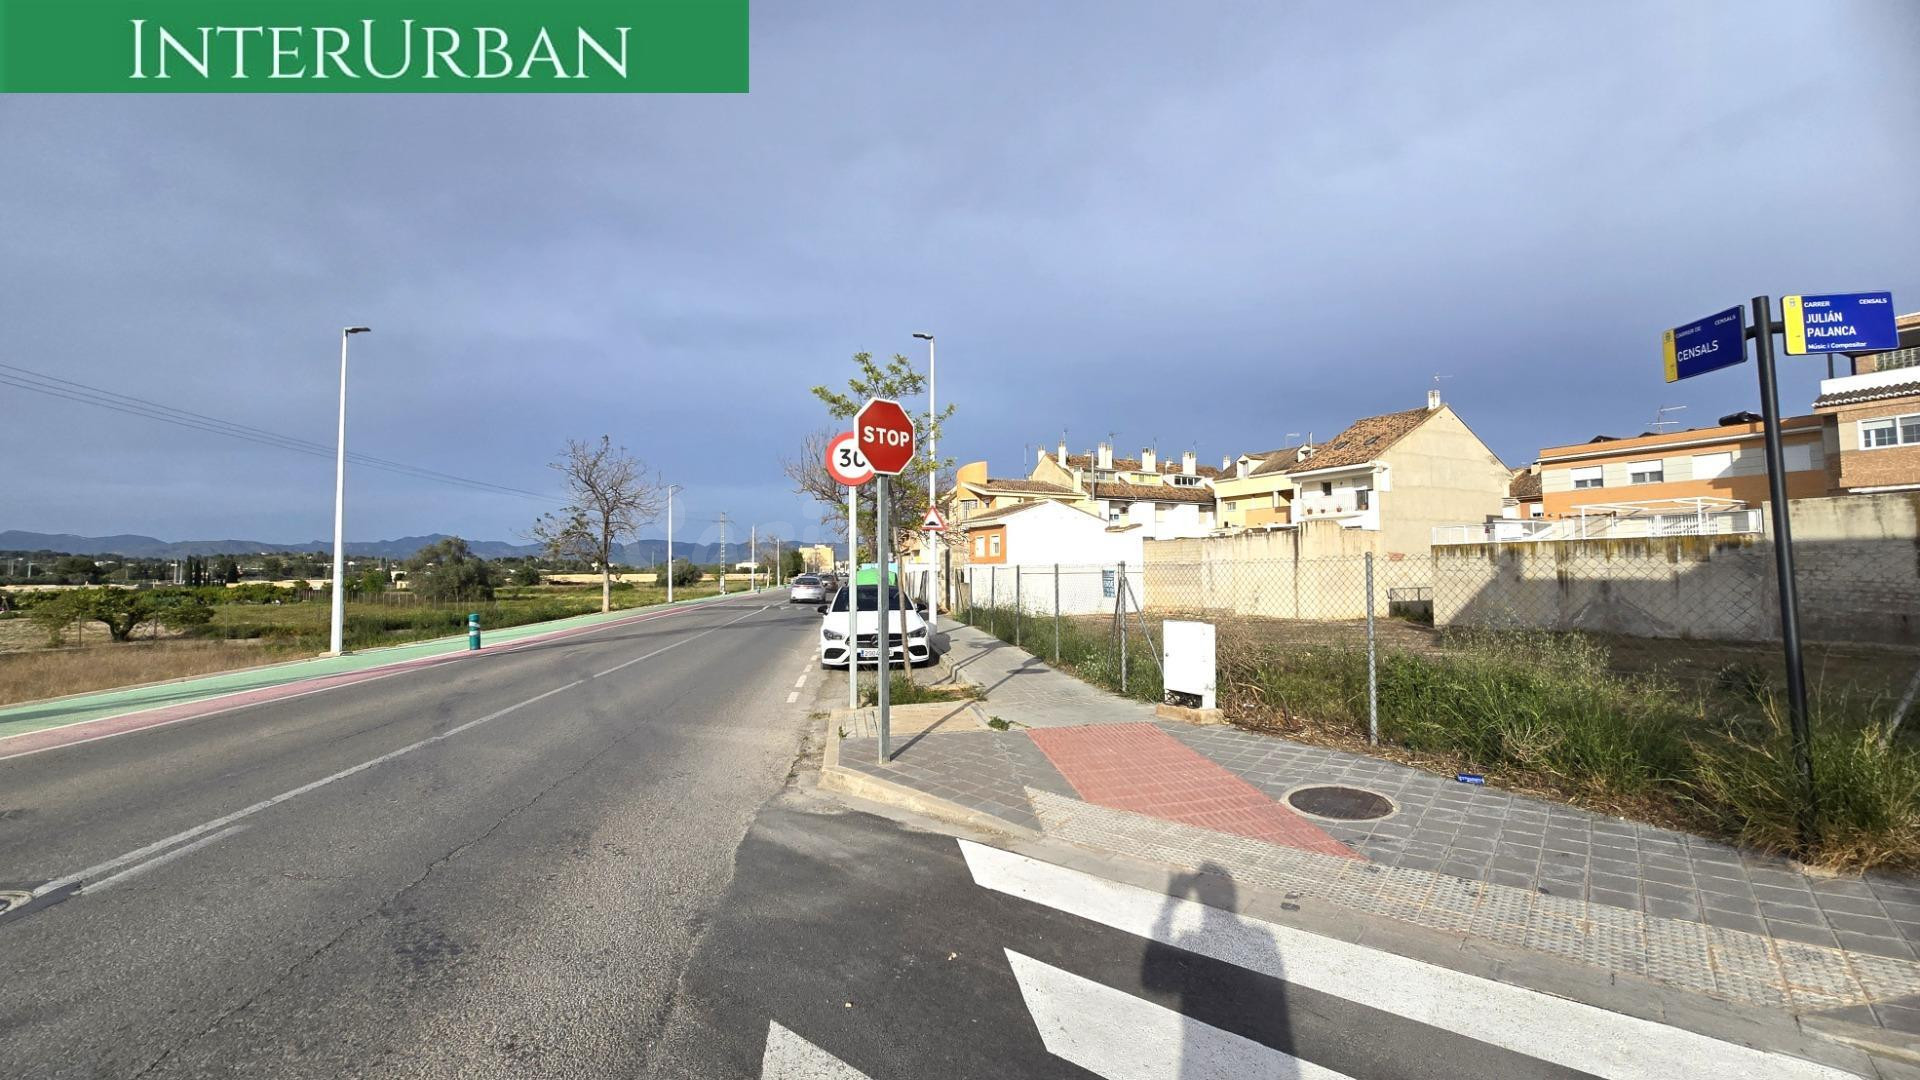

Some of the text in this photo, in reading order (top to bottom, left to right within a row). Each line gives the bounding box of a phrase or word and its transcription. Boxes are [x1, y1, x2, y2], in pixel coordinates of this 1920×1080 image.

[1714, 314, 1736, 326] CENSALS
[1805, 310, 1843, 324] JULIÁN
[1806, 325, 1857, 338] PALANCA
[1677, 340, 1719, 362] CENSALS
[1830, 341, 1867, 349] Compositor
[864, 425, 910, 447] STOP
[839, 448, 867, 468] 30
